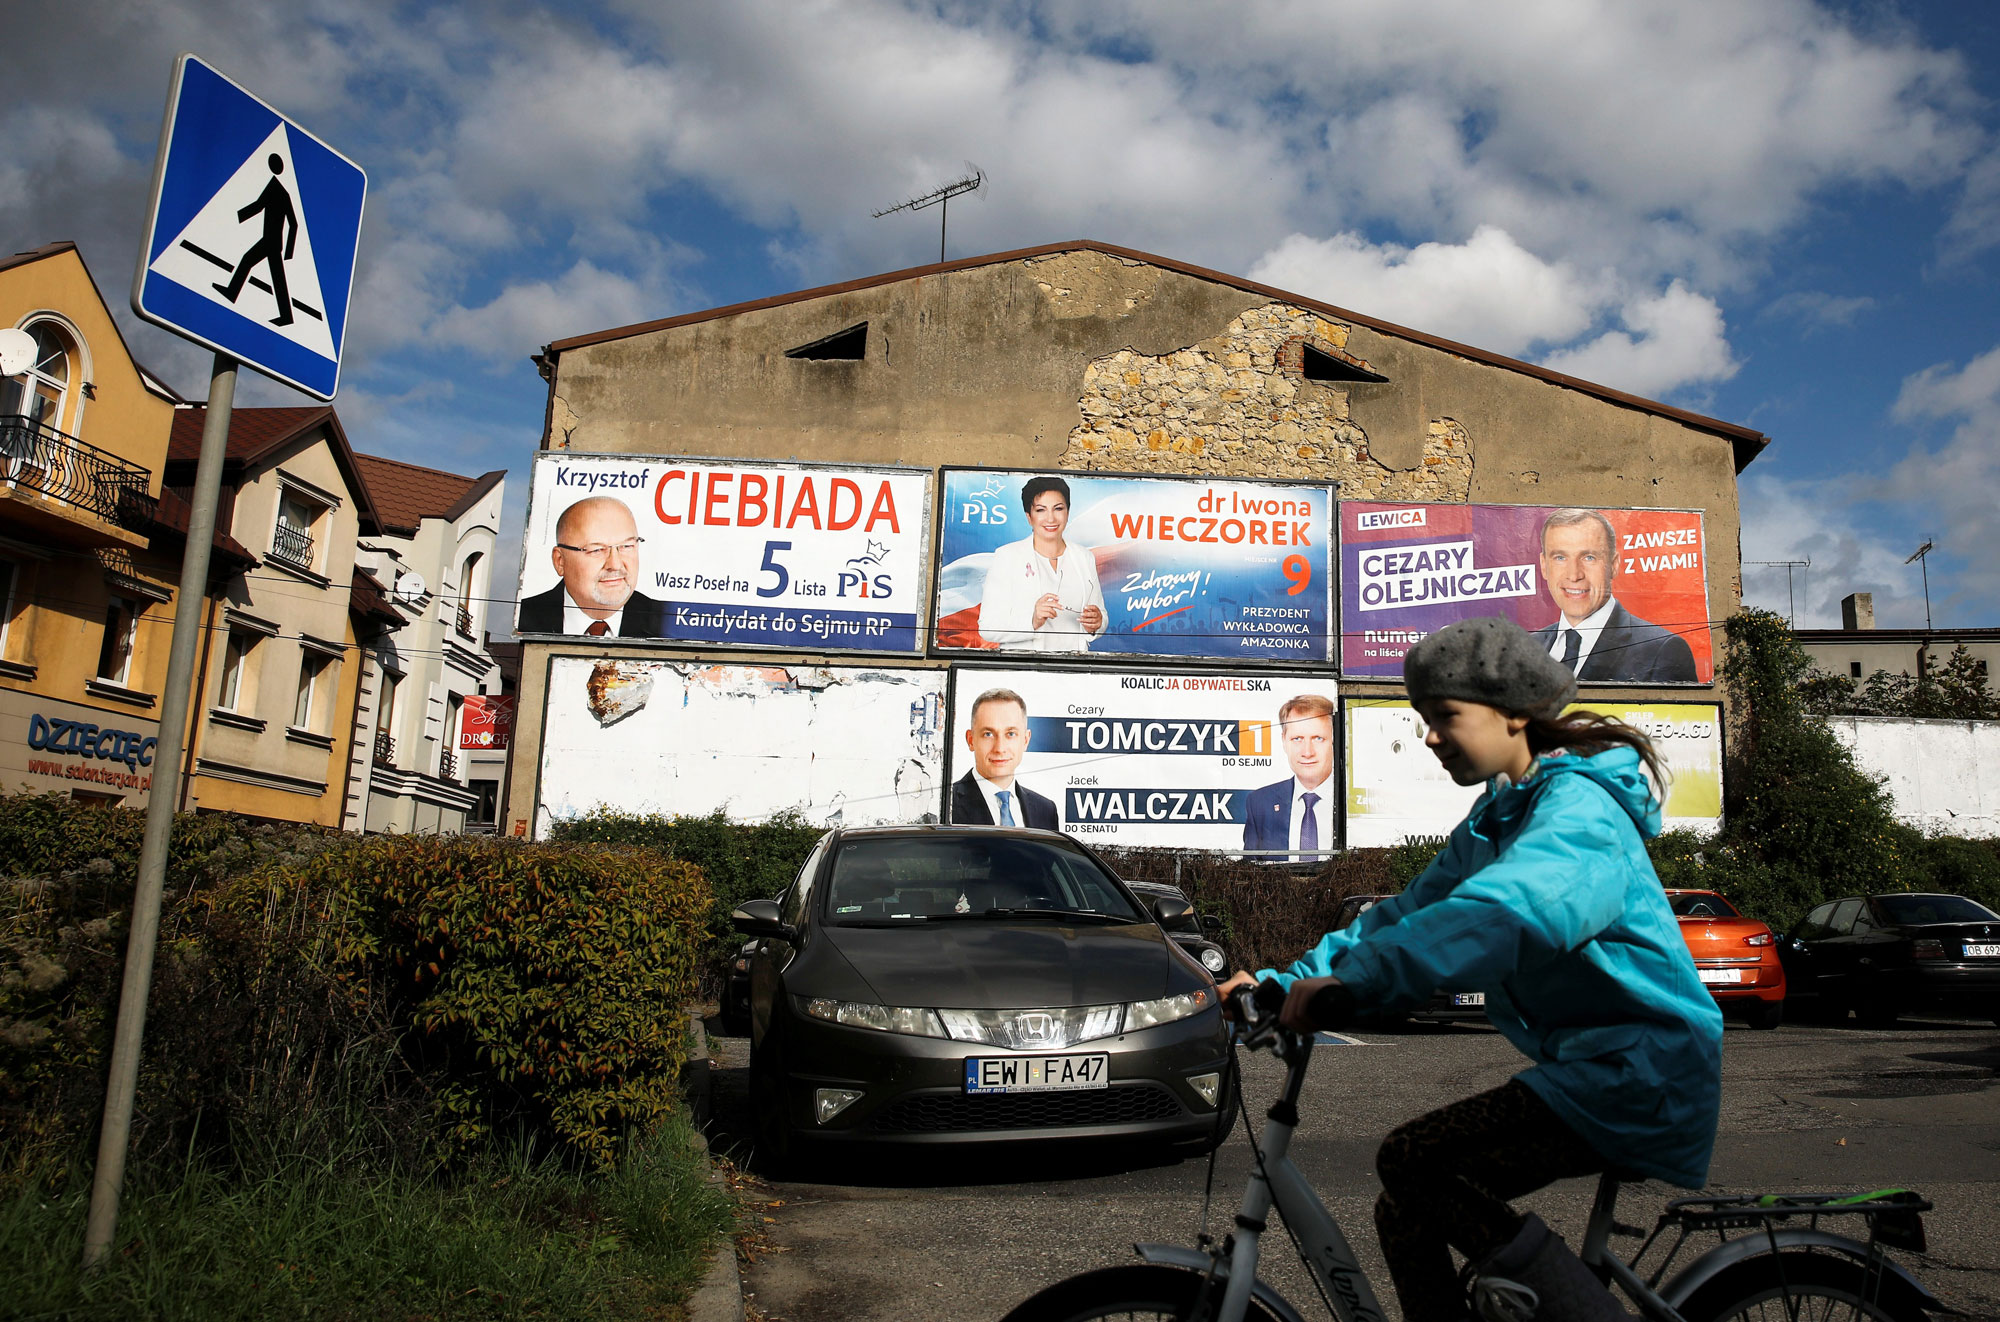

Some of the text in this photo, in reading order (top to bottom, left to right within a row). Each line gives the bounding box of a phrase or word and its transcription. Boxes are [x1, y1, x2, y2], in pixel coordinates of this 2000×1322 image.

[556, 467, 650, 492] Krzysztof
[654, 470, 901, 534] CIEBIADA
[1198, 488, 1311, 516] dr Iwona
[961, 501, 1008, 524] PiS
[1362, 511, 1422, 527] LEWICA
[1110, 513, 1311, 547] WIECZOREK
[1622, 529, 1697, 550] ZAWSZE
[655, 540, 826, 598] Wasz Poseł na 5 Lista
[1363, 547, 1469, 577] CEZARY
[1624, 552, 1698, 574] Z WAMI!
[836, 570, 893, 598] PiS
[1120, 569, 1201, 598] Zdrowy
[1281, 554, 1312, 596] 9
[1362, 568, 1531, 605] OLEJNICZAK
[675, 607, 892, 639] Kandydat do Sejmu RP
[1242, 607, 1310, 618] PREZYDENT
[1223, 621, 1310, 634] WYKŁADOWCA
[1240, 637, 1310, 649] AMAZONKA
[1364, 649, 1377, 657] na
[1379, 647, 1404, 657] liście
[1121, 677, 1272, 691] KOALICJA OBYWATELSKA
[1067, 704, 1105, 717] Cezary
[1065, 721, 1263, 753] TOMCZYK 1
[1222, 758, 1272, 767] DO SEJMU
[1067, 775, 1099, 786] Jacek
[1074, 792, 1234, 821] WALCZAK
[1065, 825, 1118, 834] DO SENATU
[1968, 945, 1982, 955] OB
[1460, 994, 1480, 1004] EWI
[982, 1057, 1104, 1086] EWI FA47
